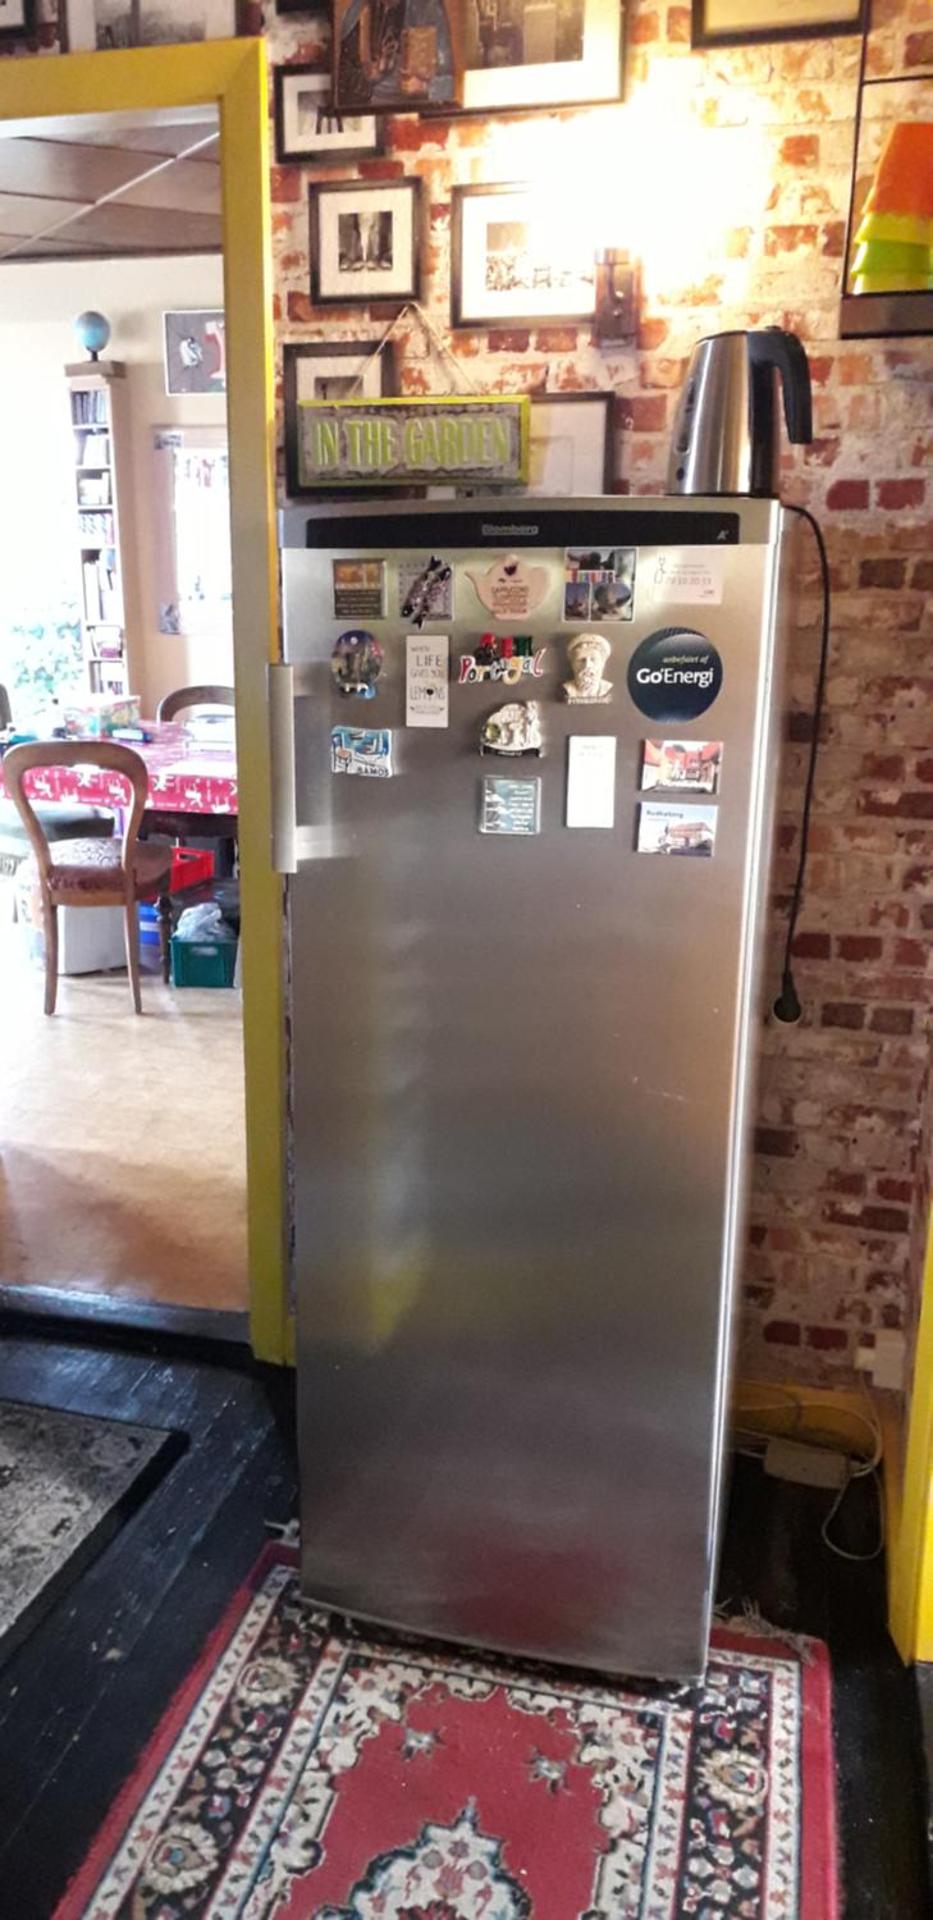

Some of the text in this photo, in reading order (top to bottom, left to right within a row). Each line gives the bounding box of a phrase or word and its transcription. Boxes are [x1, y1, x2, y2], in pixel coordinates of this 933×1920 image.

[314, 416, 511, 467] IN THE GARDEN
[416, 655, 443, 667] LIFE
[458, 647, 547, 685] Portugal
